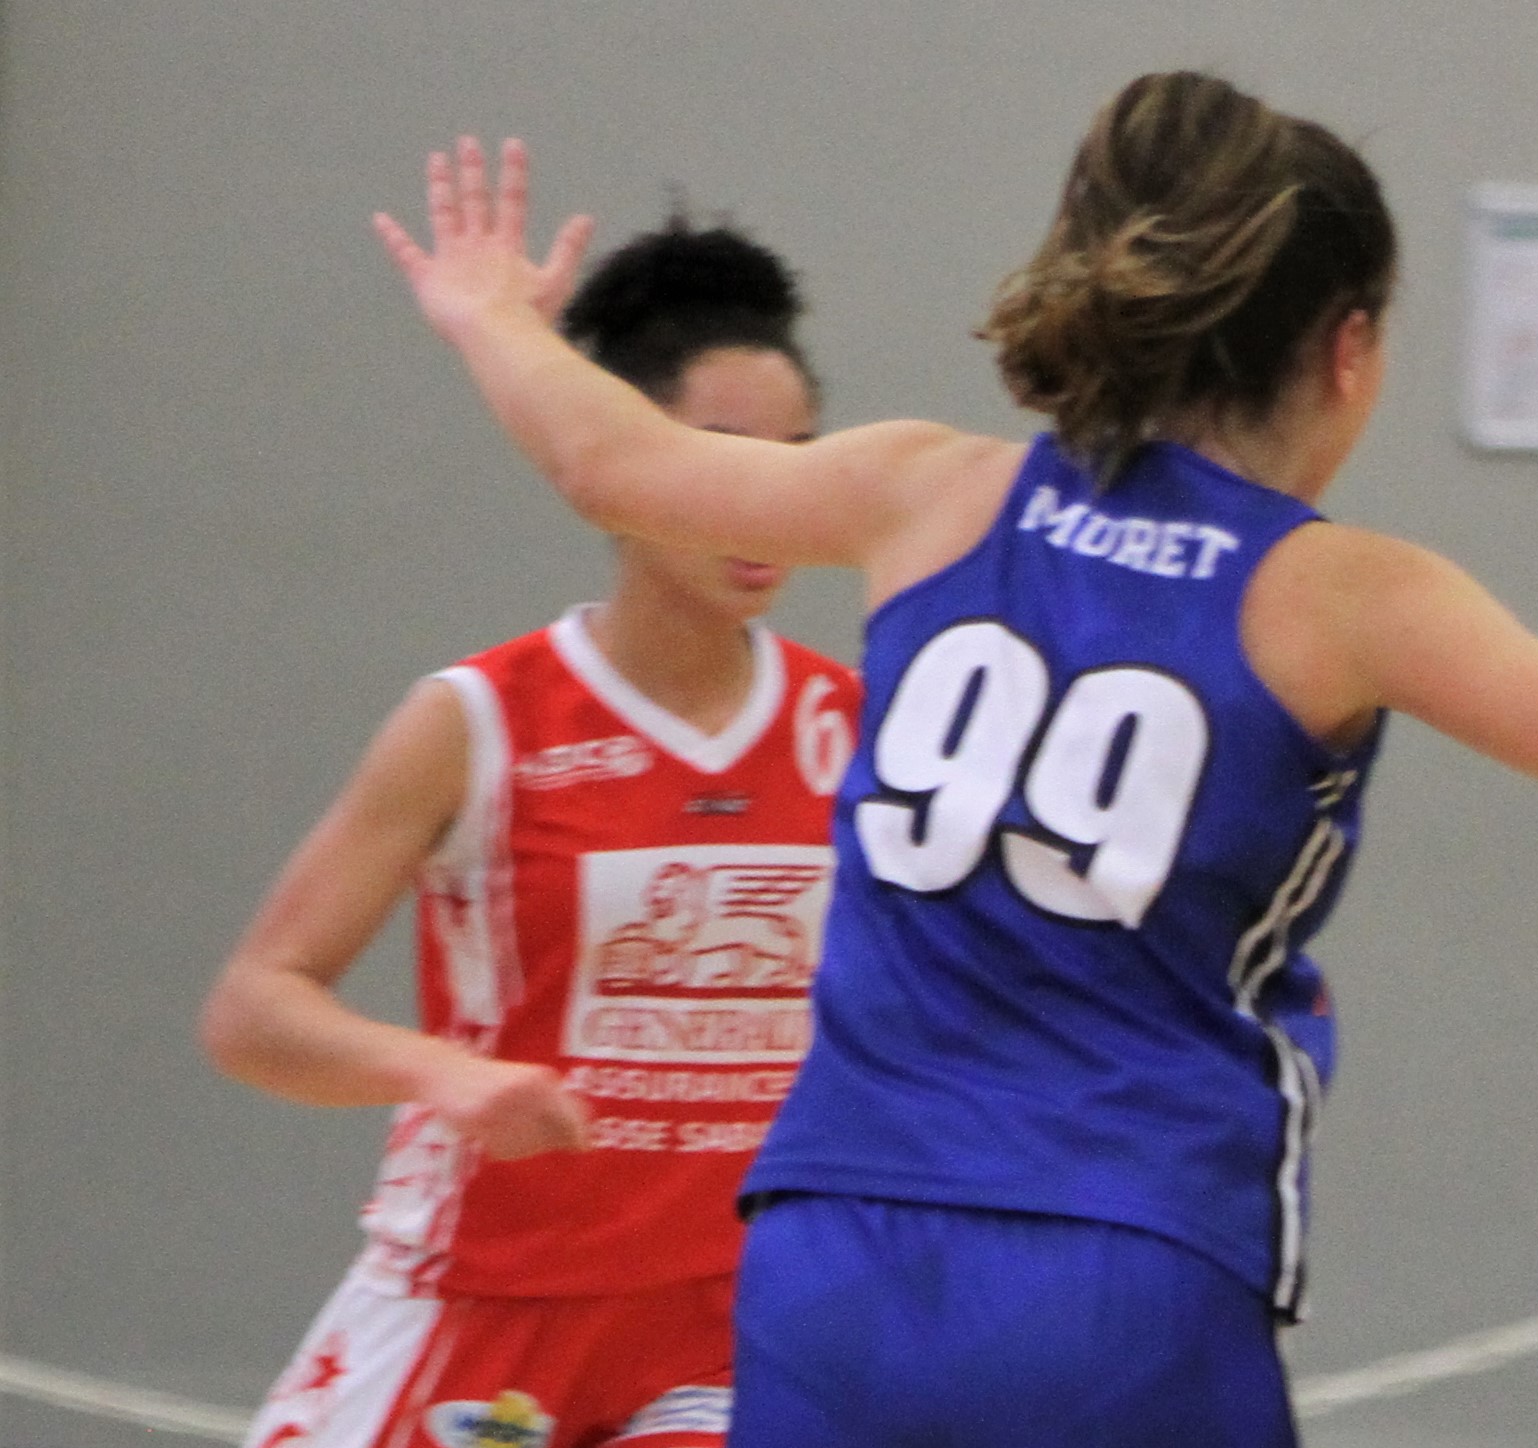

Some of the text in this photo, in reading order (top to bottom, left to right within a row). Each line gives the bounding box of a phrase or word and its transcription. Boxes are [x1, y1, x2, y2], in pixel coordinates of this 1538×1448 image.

[1018, 485, 1240, 580] MORET
[793, 673, 860, 796] 6
[855, 619, 1207, 930] 99
